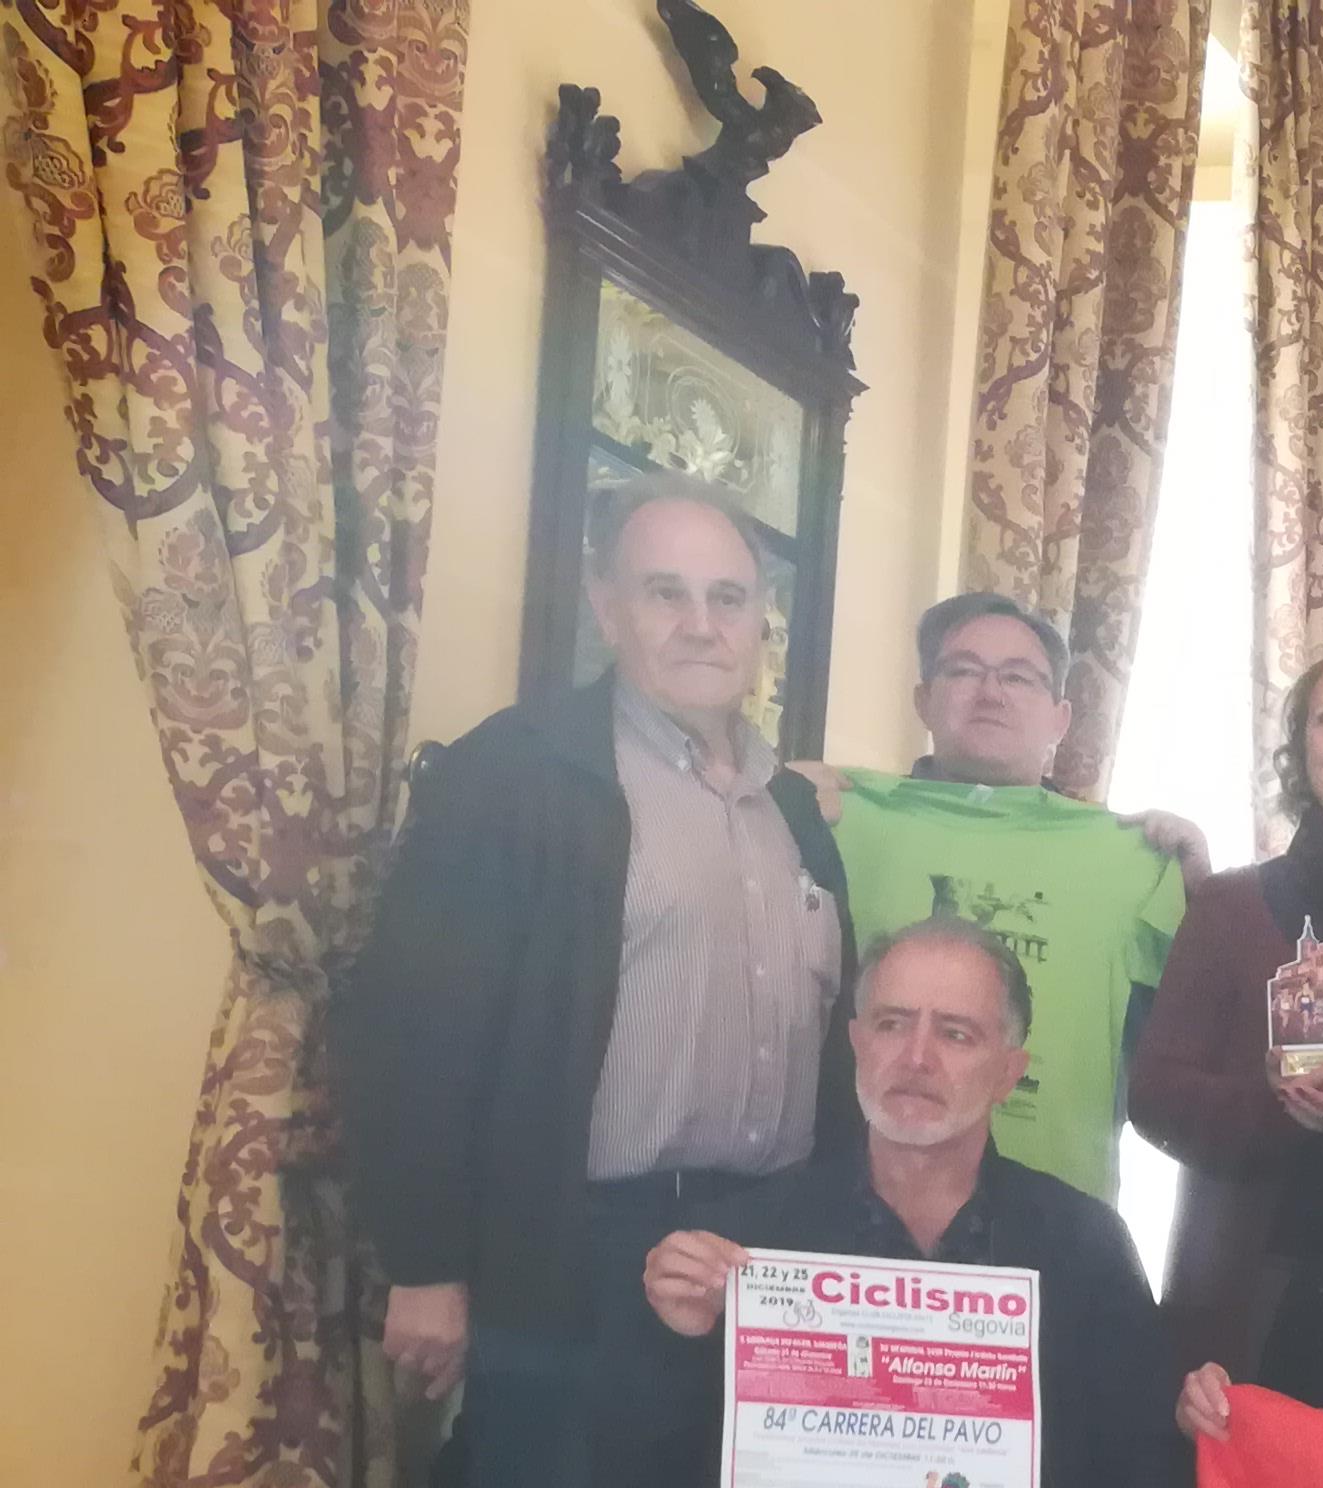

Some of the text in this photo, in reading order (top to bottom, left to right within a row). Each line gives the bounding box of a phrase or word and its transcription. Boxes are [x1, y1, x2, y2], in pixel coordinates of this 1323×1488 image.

[762, 1265, 777, 1278] 22
[782, 1269, 789, 1282] y
[811, 1270, 1028, 1317] Ciclismo
[947, 1313, 1026, 1338] Segovia
[801, 1409, 895, 1438] CARRERA
[902, 1417, 936, 1441] DEL
[943, 1419, 1003, 1444] PAVO
